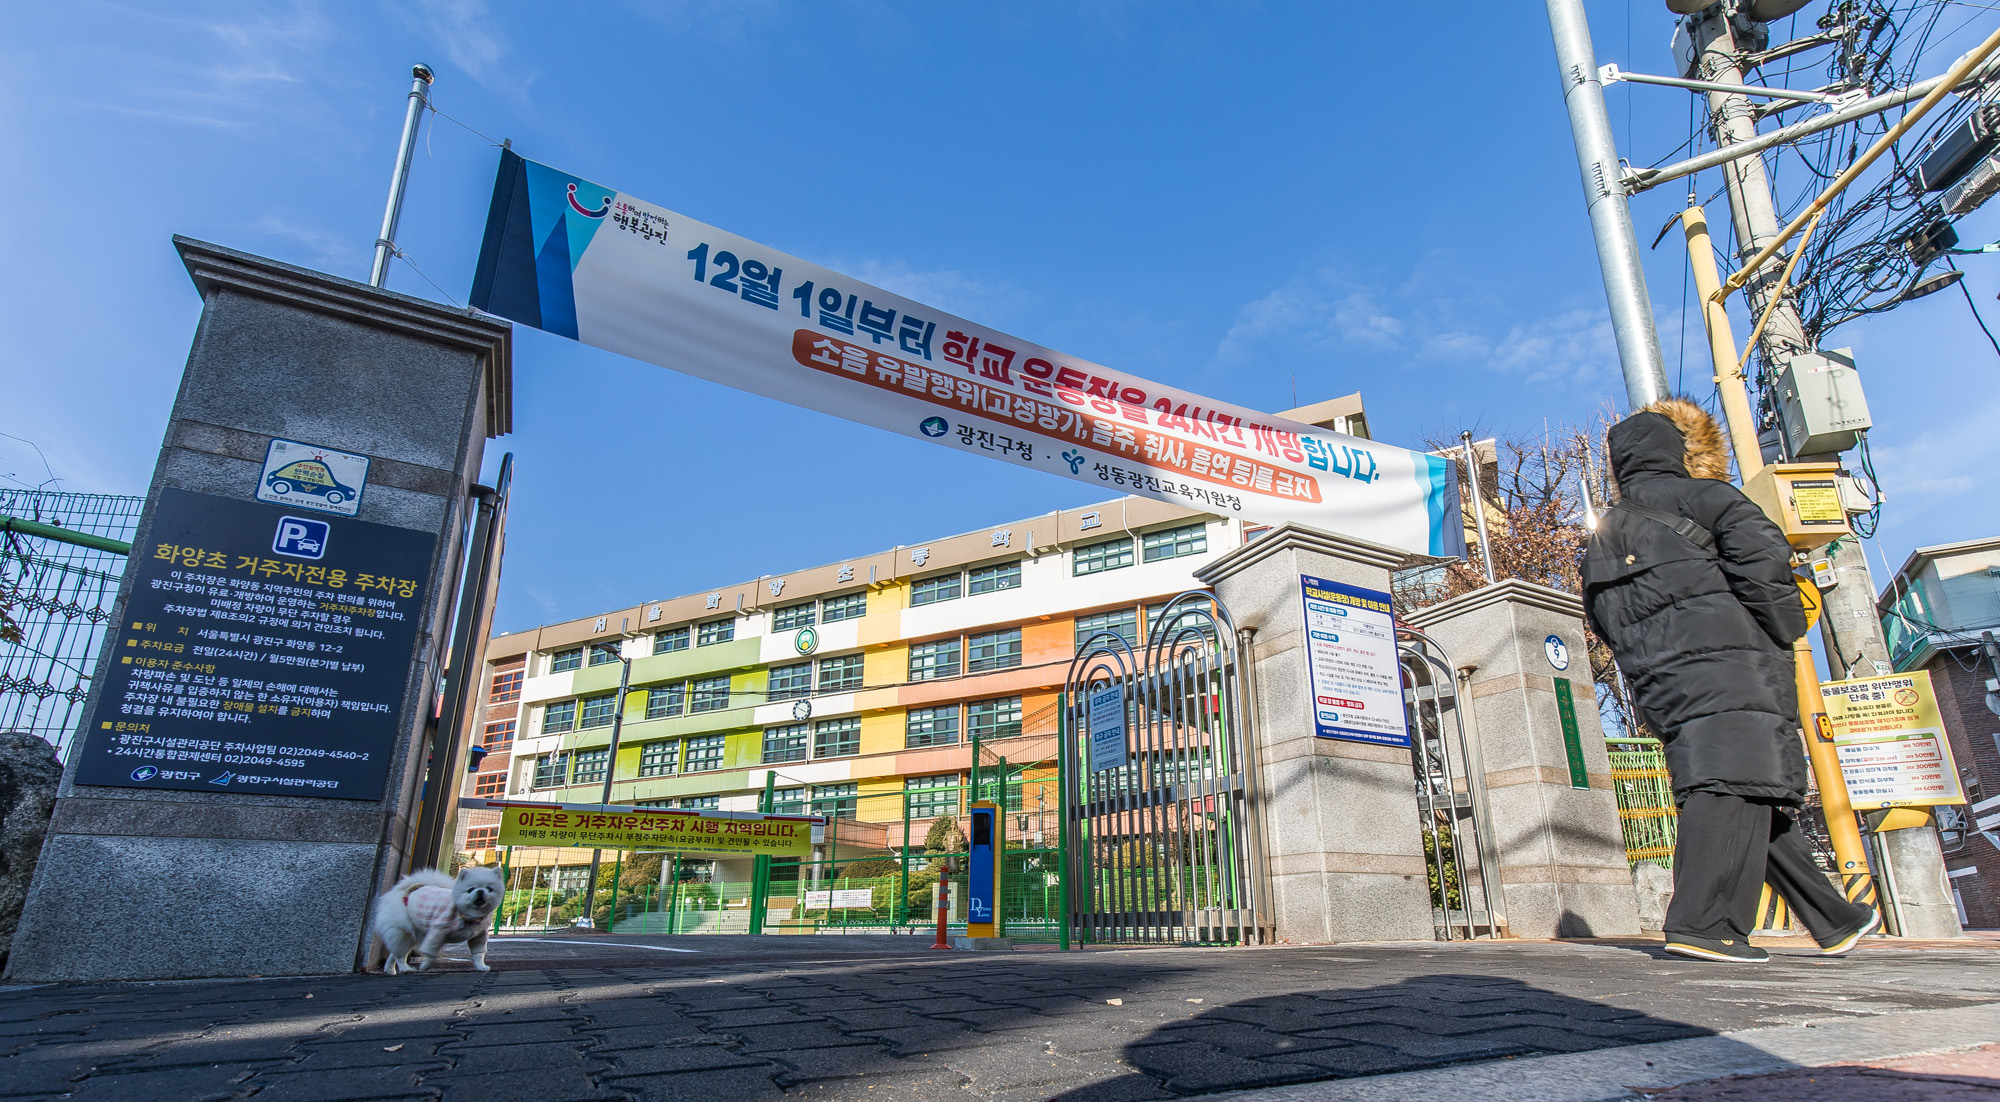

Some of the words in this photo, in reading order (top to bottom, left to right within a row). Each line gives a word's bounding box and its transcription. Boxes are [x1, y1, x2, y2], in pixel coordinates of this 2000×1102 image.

[615, 202, 641, 218] 소통하며
[643, 212, 669, 229] 발전하는
[613, 213, 668, 245] 행복광진
[687, 242, 783, 311] 12월
[793, 280, 936, 361] 1일부터
[942, 330, 1016, 386] 학교
[1020, 358, 1148, 424] 운동장을
[1153, 398, 1246, 449] 24시간
[1249, 422, 1380, 484] 개방합니다.
[811, 338, 869, 376] 소음
[874, 357, 1088, 440] 유발행위(고성방가,
[1092, 420, 1138, 455] 음주,
[1144, 433, 1187, 468] 취사,
[1190, 447, 1230, 480] 흡연
[1232, 459, 1275, 492] 등)를
[1276, 473, 1311, 500] 금지
[295, 469, 325, 479] 탄력순찰
[956, 423, 1033, 462] 광진구청
[1092, 461, 1242, 511] 성동광진교육지원청
[279, 524, 307, 548] P
[154, 543, 228, 569] 화양초
[236, 556, 348, 588] 거주자전용
[354, 573, 418, 598] 주차장
[151, 579, 206, 594] 광진구청이
[277, 596, 317, 609] 운영하는
[320, 602, 406, 621] 거주자주차장입니다.
[170, 571, 182, 580] 이
[184, 572, 227, 586] 주차장은
[229, 578, 260, 591] 화양동
[263, 584, 313, 598] 지역주민의
[315, 591, 335, 600] 주차
[337, 593, 366, 606] 편의를
[368, 598, 396, 610] 위하여
[164, 604, 207, 618] 주차장법
[210, 610, 256, 622] 제8조의2
[258, 616, 289, 627] 규정에
[291, 620, 311, 630] 의거
[314, 622, 352, 635] 견인조치
[355, 628, 385, 640] 됩니다.
[210, 599, 242, 610] 미배정
[244, 602, 275, 615] 차량이
[277, 608, 298, 618] 무단
[300, 611, 330, 622] 주차할
[332, 615, 351, 624] 경우
[145, 622, 157, 632] 위
[178, 627, 189, 636] 치
[197, 629, 251, 643] 서울특별시
[252, 635, 284, 646] 광진구
[285, 640, 316, 651] 화양동
[320, 644, 343, 653] 12-2
[140, 640, 185, 653] 주차요금
[193, 646, 258, 661] 전일(24시간)
[1554, 649, 1559, 658] 9
[135, 657, 169, 668] 이용자
[171, 661, 216, 674] 준수사항
[131, 668, 176, 681] 차량파손
[180, 673, 191, 683] 및
[193, 675, 215, 685] 도난
[218, 677, 229, 686] 등
[232, 679, 263, 690] 일체의
[266, 682, 297, 693] 손해에
[299, 685, 339, 698] 대해서는
[1822, 684, 1868, 696] 동물보호법
[1871, 679, 1913, 689] 위반행위
[124, 692, 159, 703] 주차장
[162, 695, 173, 705] 내
[176, 697, 220, 709] 불필요한
[222, 701, 255, 712] 장애물
[258, 704, 288, 716] 설치를
[291, 706, 331, 719] 금지하며
[128, 680, 184, 694] 귀책사유를
[187, 686, 231, 699] 입증하지
[233, 690, 255, 701] 않는
[258, 692, 268, 702] 한
[270, 694, 339, 709] 소유자(이용자)
[341, 700, 391, 713] 책임입니다.
[1848, 693, 1869, 702] 단속
[1871, 691, 1885, 700] 중!
[121, 703, 155, 716] 청결을
[158, 707, 214, 720] 유지하여야
[217, 711, 251, 723] 합니다.
[115, 721, 150, 733] 문의처
[119, 734, 222, 751] 광진구시설관리공단
[223, 742, 277, 755] 주차사업팀
[115, 747, 222, 763] 24시간통합관제센터
[224, 755, 305, 768] 02)2049-4595
[160, 770, 201, 780] 광진구
[518, 812, 568, 828] 이곳은
[574, 814, 685, 832] 거주자우선주차
[690, 820, 719, 834] 시행
[724, 822, 798, 837] 지역입니다.
[519, 829, 546, 839] 미배정
[550, 830, 576, 840] 차량이
[580, 831, 623, 842] 무단주차시
[717, 837, 725, 845] 및
[727, 837, 750, 846] 견인될
[753, 839, 760, 847] 수
[763, 839, 795, 848] 있습니다.
